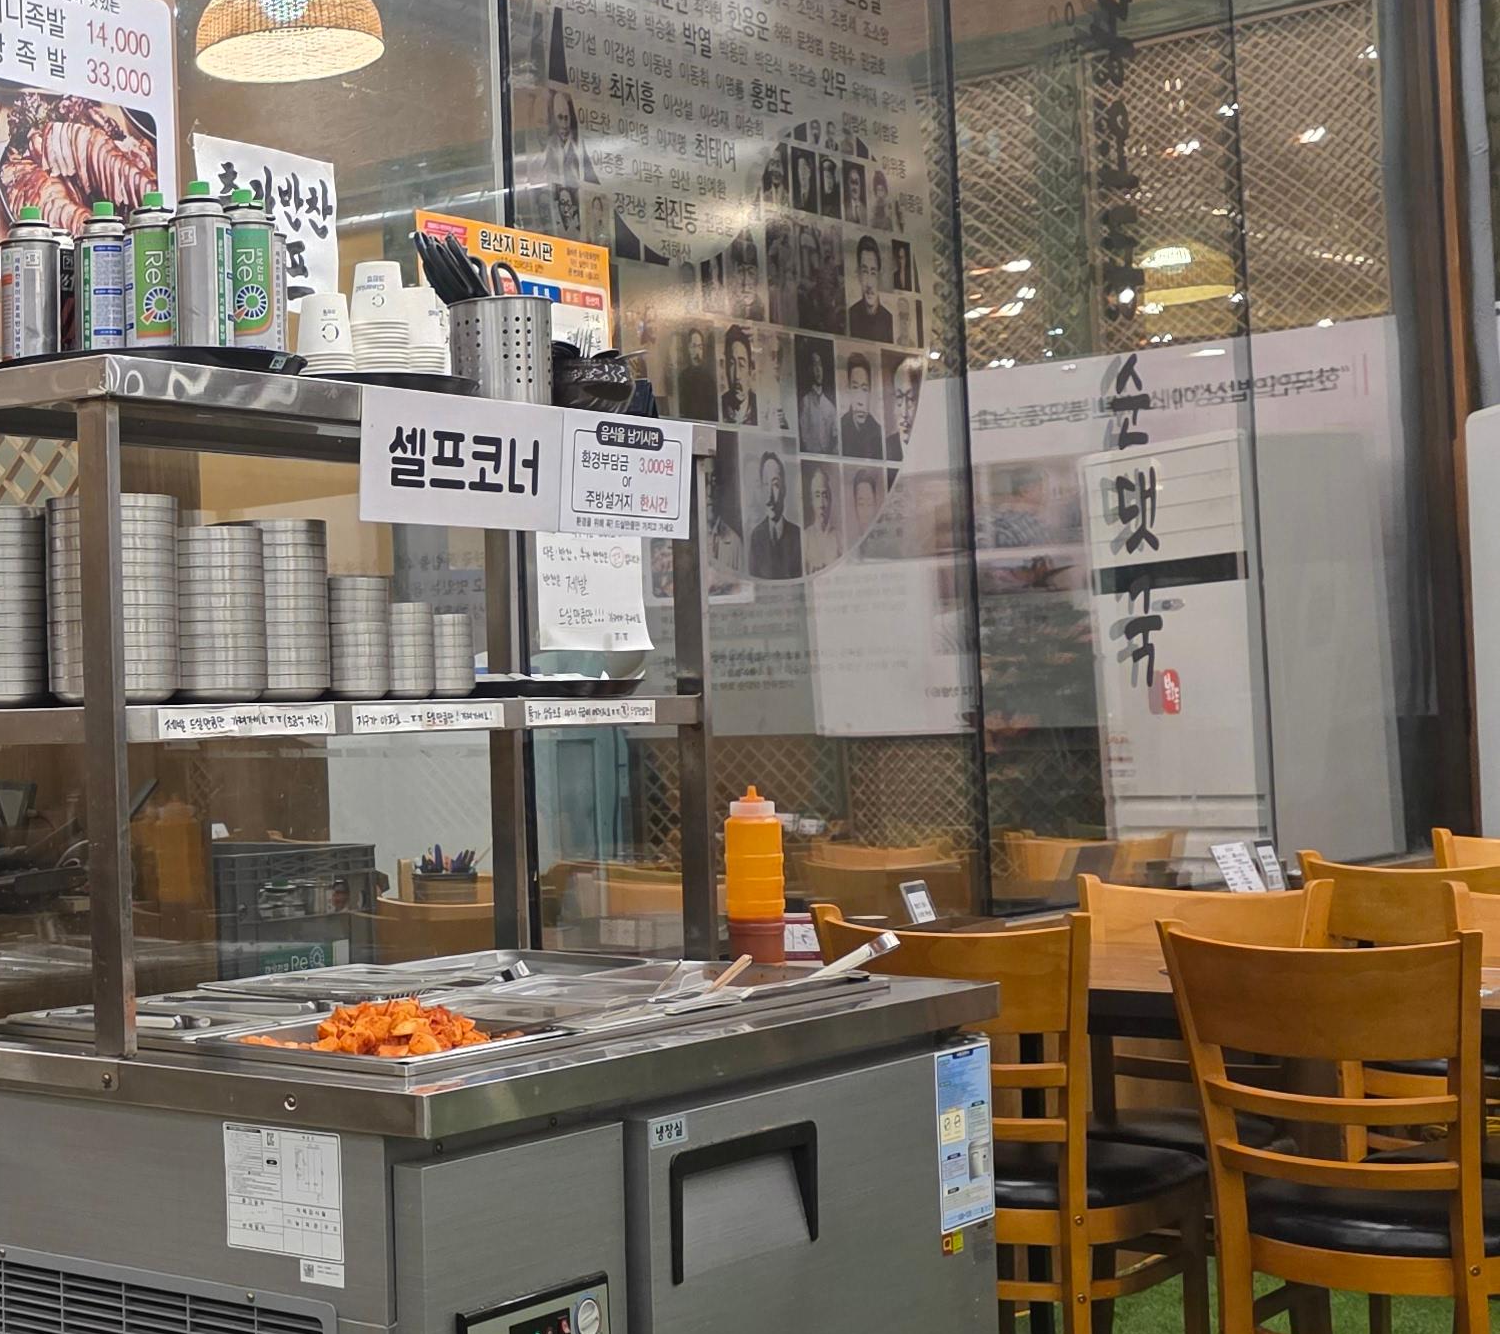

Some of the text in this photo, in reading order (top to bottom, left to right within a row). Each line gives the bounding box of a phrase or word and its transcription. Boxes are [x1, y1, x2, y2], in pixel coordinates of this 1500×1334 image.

[86, 18, 151, 59] 14,000
[15, 38, 37, 72] 족
[47, 46, 67, 80] 발
[86, 57, 152, 97] 33,000
[682, 21, 712, 59] 박열
[821, 66, 848, 100] 안무
[608, 72, 656, 115] 최치흥
[750, 78, 794, 116] 홍범도
[694, 132, 737, 173] 최태여
[613, 192, 647, 219] 장건상
[653, 195, 698, 235] 최진동
[479, 228, 516, 255] 원산지
[518, 237, 554, 263] 표시판
[600, 425, 660, 447] 음식을 남기시면
[388, 425, 540, 497] 셀프코너
[581, 449, 675, 477] 환경부담금 3,000원
[621, 475, 633, 488] or
[585, 490, 669, 514] 주방설거지 한시간
[1107, 352, 1164, 688] 순댓국
[655, 1120, 683, 1142] 냉장실
